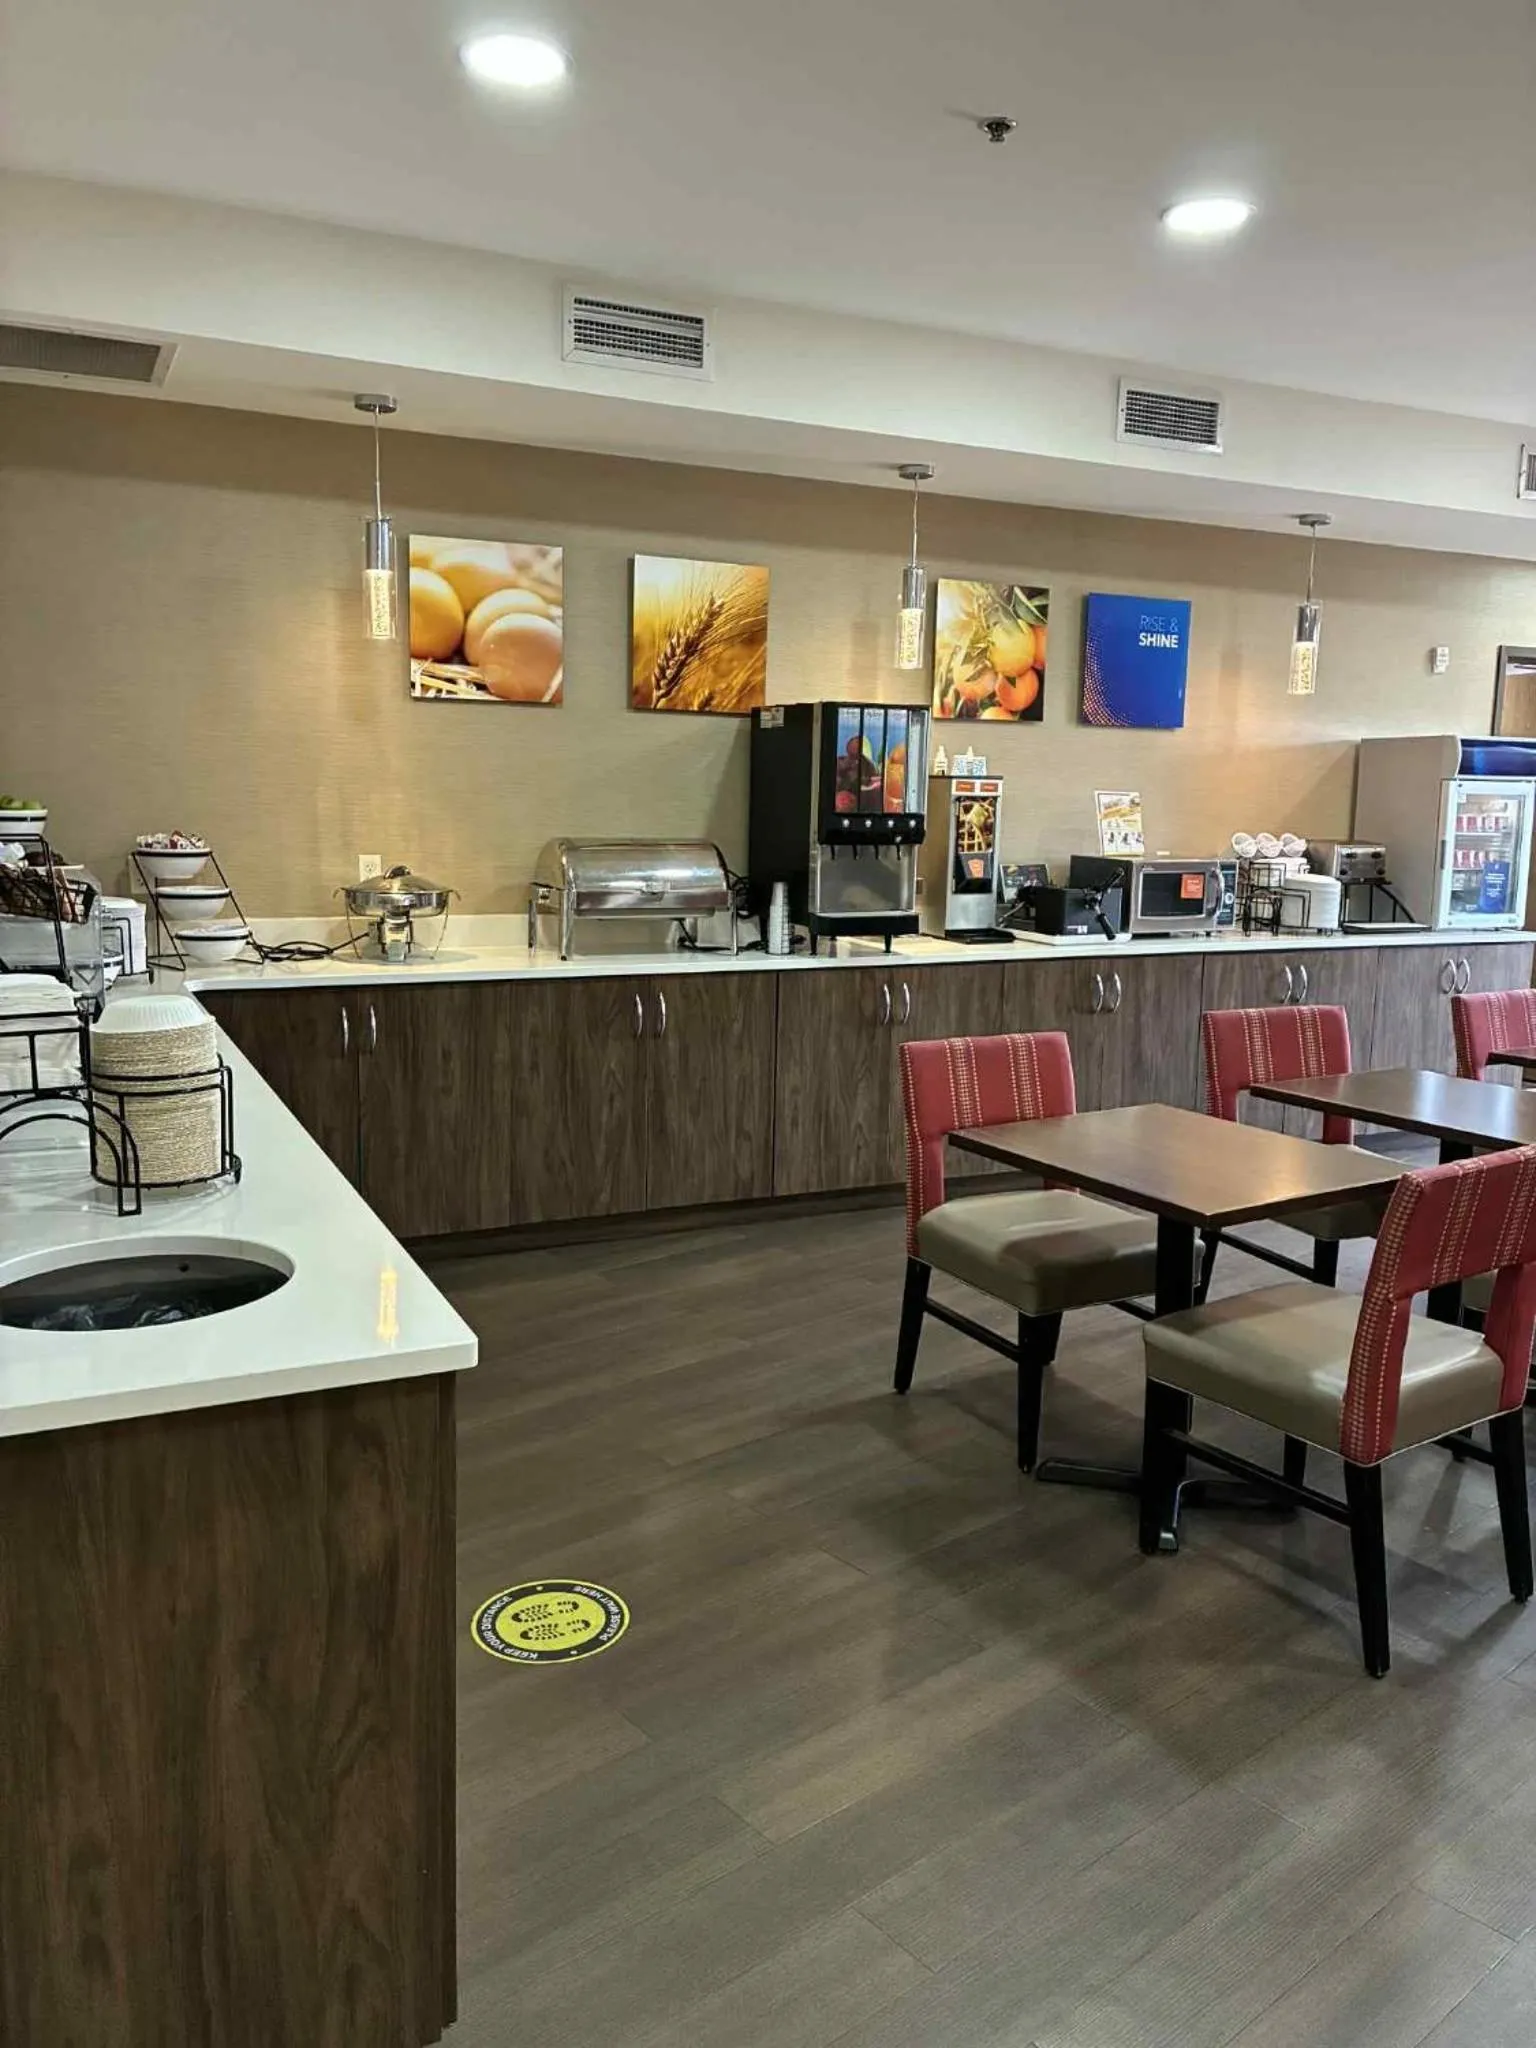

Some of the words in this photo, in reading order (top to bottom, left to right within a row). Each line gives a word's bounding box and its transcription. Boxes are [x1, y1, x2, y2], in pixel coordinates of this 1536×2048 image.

[1140, 615, 1166, 632] RISE
[1170, 617, 1179, 633] &
[1138, 632, 1179, 648] SHINE
[481, 1596, 513, 1630] DISTANCE
[599, 1597, 621, 1614] WAIT
[599, 1614, 621, 1641] PLEASE
[483, 1630, 505, 1651] YOUR
[504, 1648, 538, 1660] KEEP
